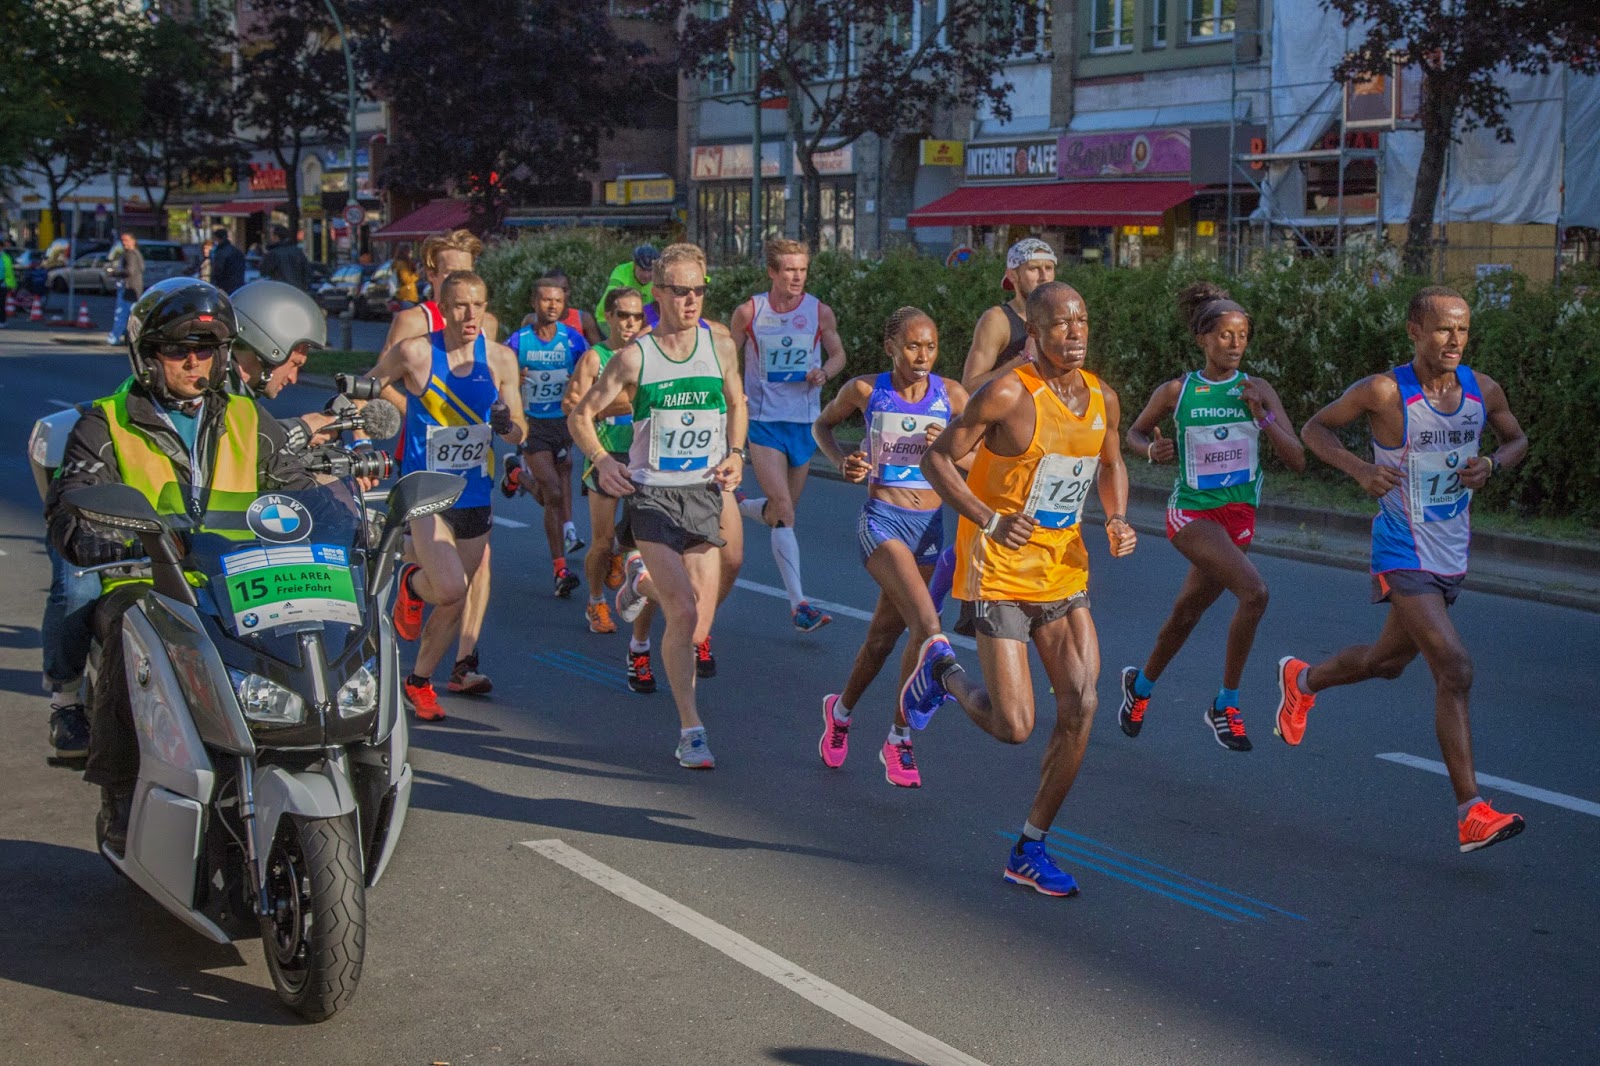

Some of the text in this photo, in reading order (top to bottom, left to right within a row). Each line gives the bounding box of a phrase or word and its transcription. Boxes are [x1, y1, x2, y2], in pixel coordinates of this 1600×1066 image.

[967, 144, 1057, 176] INTERNET CAFE
[770, 350, 807, 366] 112
[530, 383, 563, 397] 153
[663, 392, 710, 407] RAHENY
[1191, 408, 1246, 418] ETHIOPIA
[665, 430, 711, 449] 109
[1420, 430, 1476, 445] 安川電機
[437, 442, 484, 461] 8762
[883, 442, 929, 456] CHERON
[1204, 448, 1243, 463] KEBEDE
[1048, 479, 1091, 502] 128
[250, 495, 303, 513] BMW
[274, 571, 331, 582] ALL AREA
[235, 577, 268, 602] 15
[277, 583, 332, 594] Freie Fahrt
